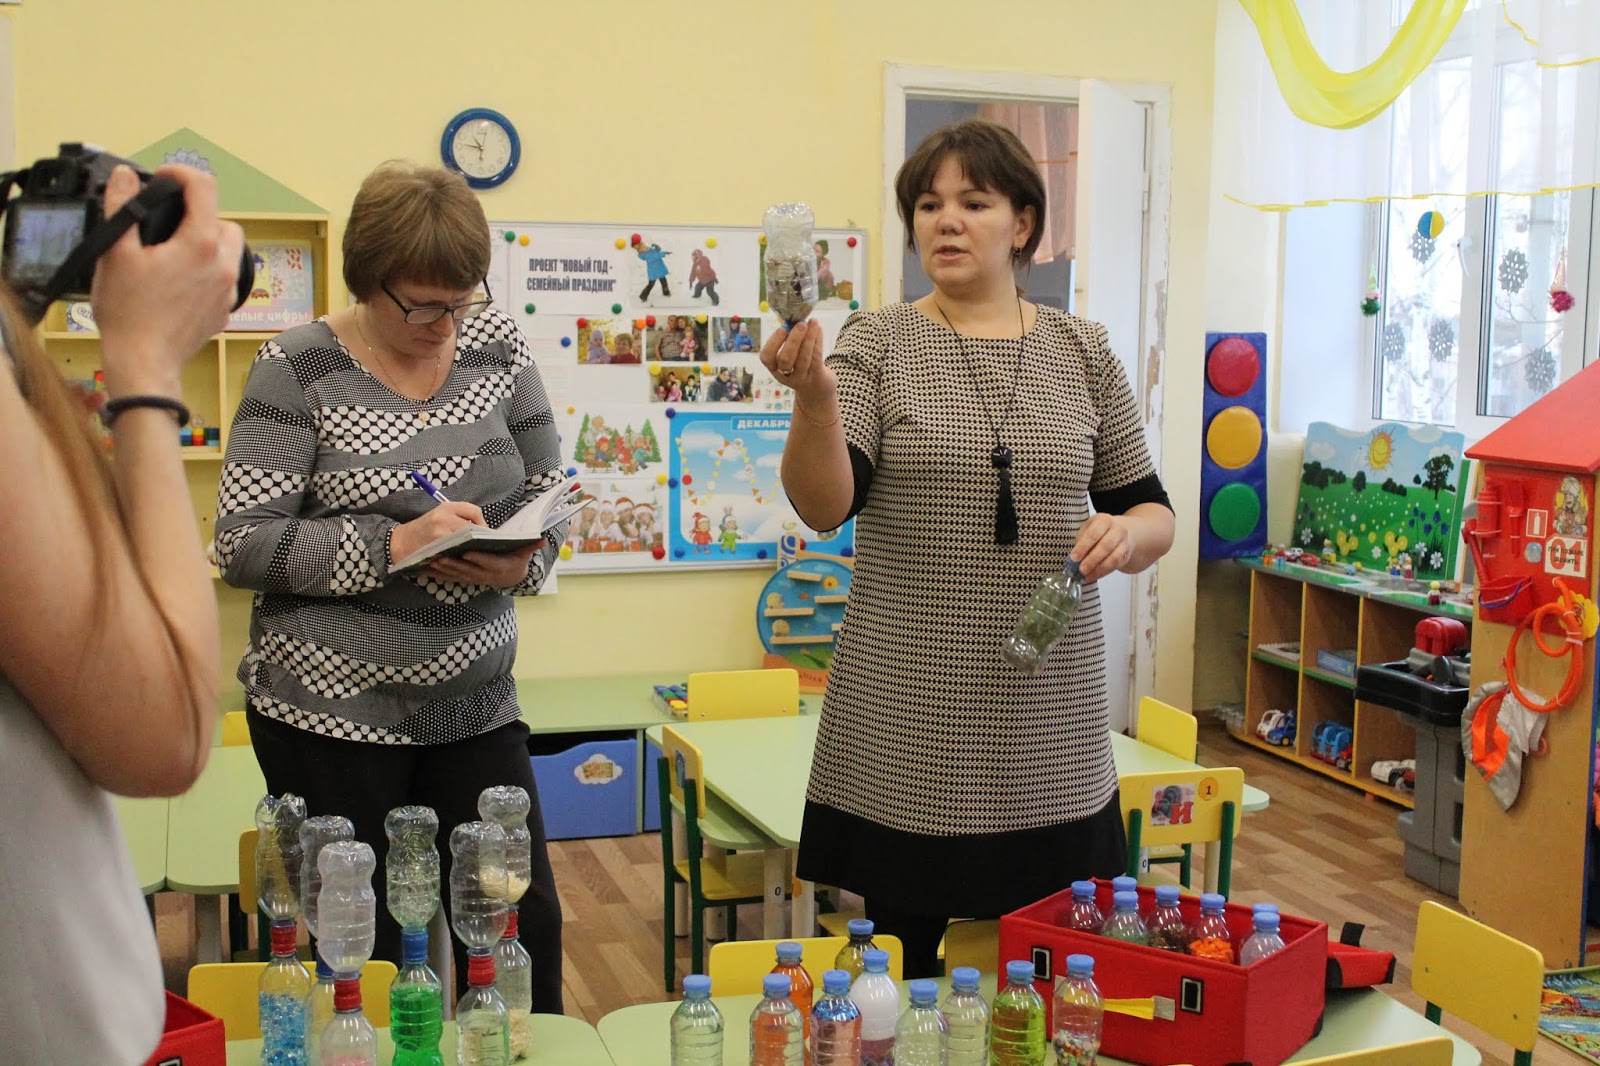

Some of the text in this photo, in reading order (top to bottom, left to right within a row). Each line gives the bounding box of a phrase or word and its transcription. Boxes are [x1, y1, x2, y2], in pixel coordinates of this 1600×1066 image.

[529, 258, 558, 271] ПРОЕКТ
[560, 257, 591, 272] "НОВЫЙ
[593, 260, 608, 274] ГОД
[527, 275, 616, 293] СЕМЕЙНЫЙ ПРАЗДНИК"
[267, 308, 308, 322] цифры
[1551, 539, 1582, 572] 01
[1206, 786, 1211, 795] 1
[1169, 801, 1193, 825] И
[774, 886, 781, 896] 0
